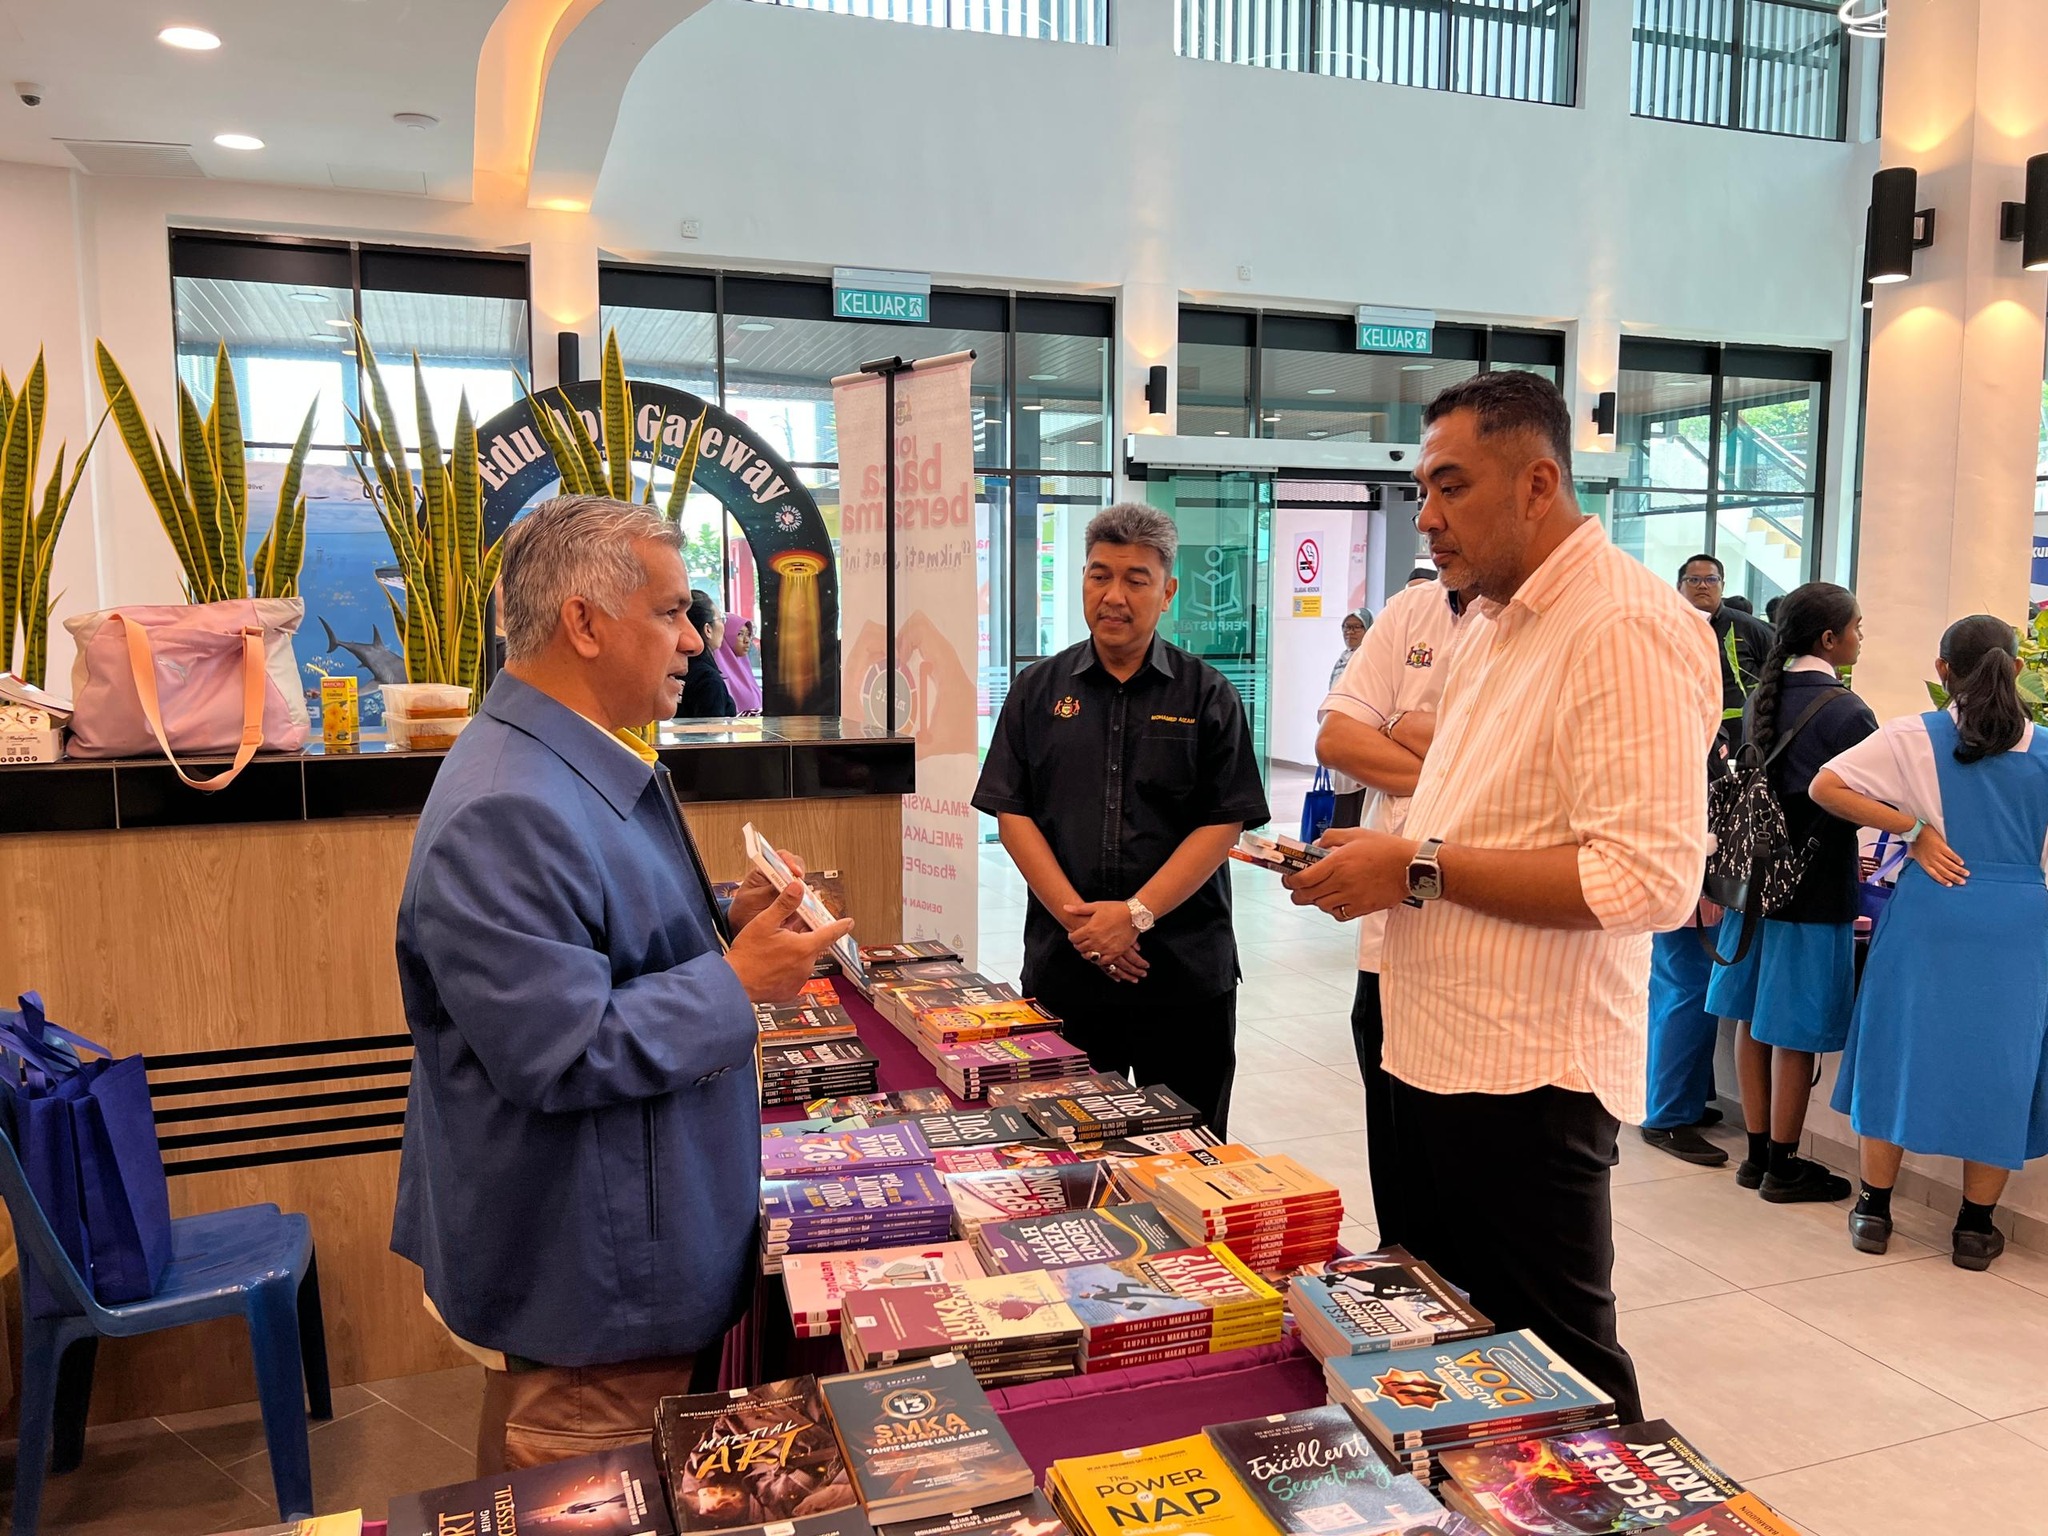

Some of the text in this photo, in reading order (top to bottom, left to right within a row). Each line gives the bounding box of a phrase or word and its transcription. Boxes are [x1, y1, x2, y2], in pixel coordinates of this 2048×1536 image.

[841, 291, 905, 317] KELUAR
[1362, 325, 1414, 349] KELUAR
[479, 425, 546, 491] Edu
[1077, 1095, 1123, 1120] BLIND
[1105, 1090, 1160, 1117] SPOT
[920, 1115, 962, 1144] BLIND
[950, 1113, 999, 1142] SPOT
[1102, 1122, 1116, 1130] BLIND
[1103, 1129, 1116, 1137] BLIND
[1117, 1128, 1128, 1136] SPOT
[1021, 1168, 1067, 1209] READING
[1019, 1225, 1064, 1265] ALLAH
[1041, 1222, 1086, 1264] MAHA
[1061, 1219, 1108, 1262] FUNDER
[820, 1261, 838, 1299] Panduan
[1150, 1256, 1214, 1301] MAKAN
[933, 1298, 975, 1341] LUKA
[949, 1284, 991, 1339] SEMALAM
[1125, 1321, 1150, 1333] SAMPAI
[1152, 1319, 1167, 1328] BILA
[1169, 1314, 1190, 1326] MAKAN
[1330, 1292, 1385, 1336] LEADERSHIP
[1362, 1302, 1408, 1334] QUOTES
[974, 1341, 1003, 1349] SEMALAM
[1123, 1339, 1148, 1349] SAMPAI
[1150, 1336, 1165, 1345] BILA
[1167, 1331, 1189, 1343] MAKAN
[970, 1358, 1000, 1367] SEMALAM
[1120, 1356, 1145, 1366] SAMPAI
[1148, 1353, 1163, 1361] BILA
[1164, 1347, 1187, 1358] MAKAN
[1435, 1355, 1502, 1409] MUSTAJAB
[1455, 1349, 1535, 1407] DOA
[894, 1397, 926, 1414] 13
[699, 1419, 798, 1452] MARTIAL
[866, 1429, 989, 1455] TAHFIZ MODEL ULUL ALBAB
[873, 1413, 968, 1440] SMKA
[876, 1425, 971, 1447] PUTRAJAYA
[695, 1422, 815, 1480] ART
[1247, 1433, 1369, 1480] Excellent
[1096, 1468, 1208, 1498] POWER
[1107, 1475, 1129, 1483] The
[1268, 1463, 1391, 1501] Secretary
[1568, 1438, 1681, 1519] SECRET
[1625, 1442, 1729, 1503] ARMY
[481, 1509, 491, 1533] BEING
[494, 1484, 517, 1536] CESSFUL
[1106, 1488, 1221, 1527] NAP
